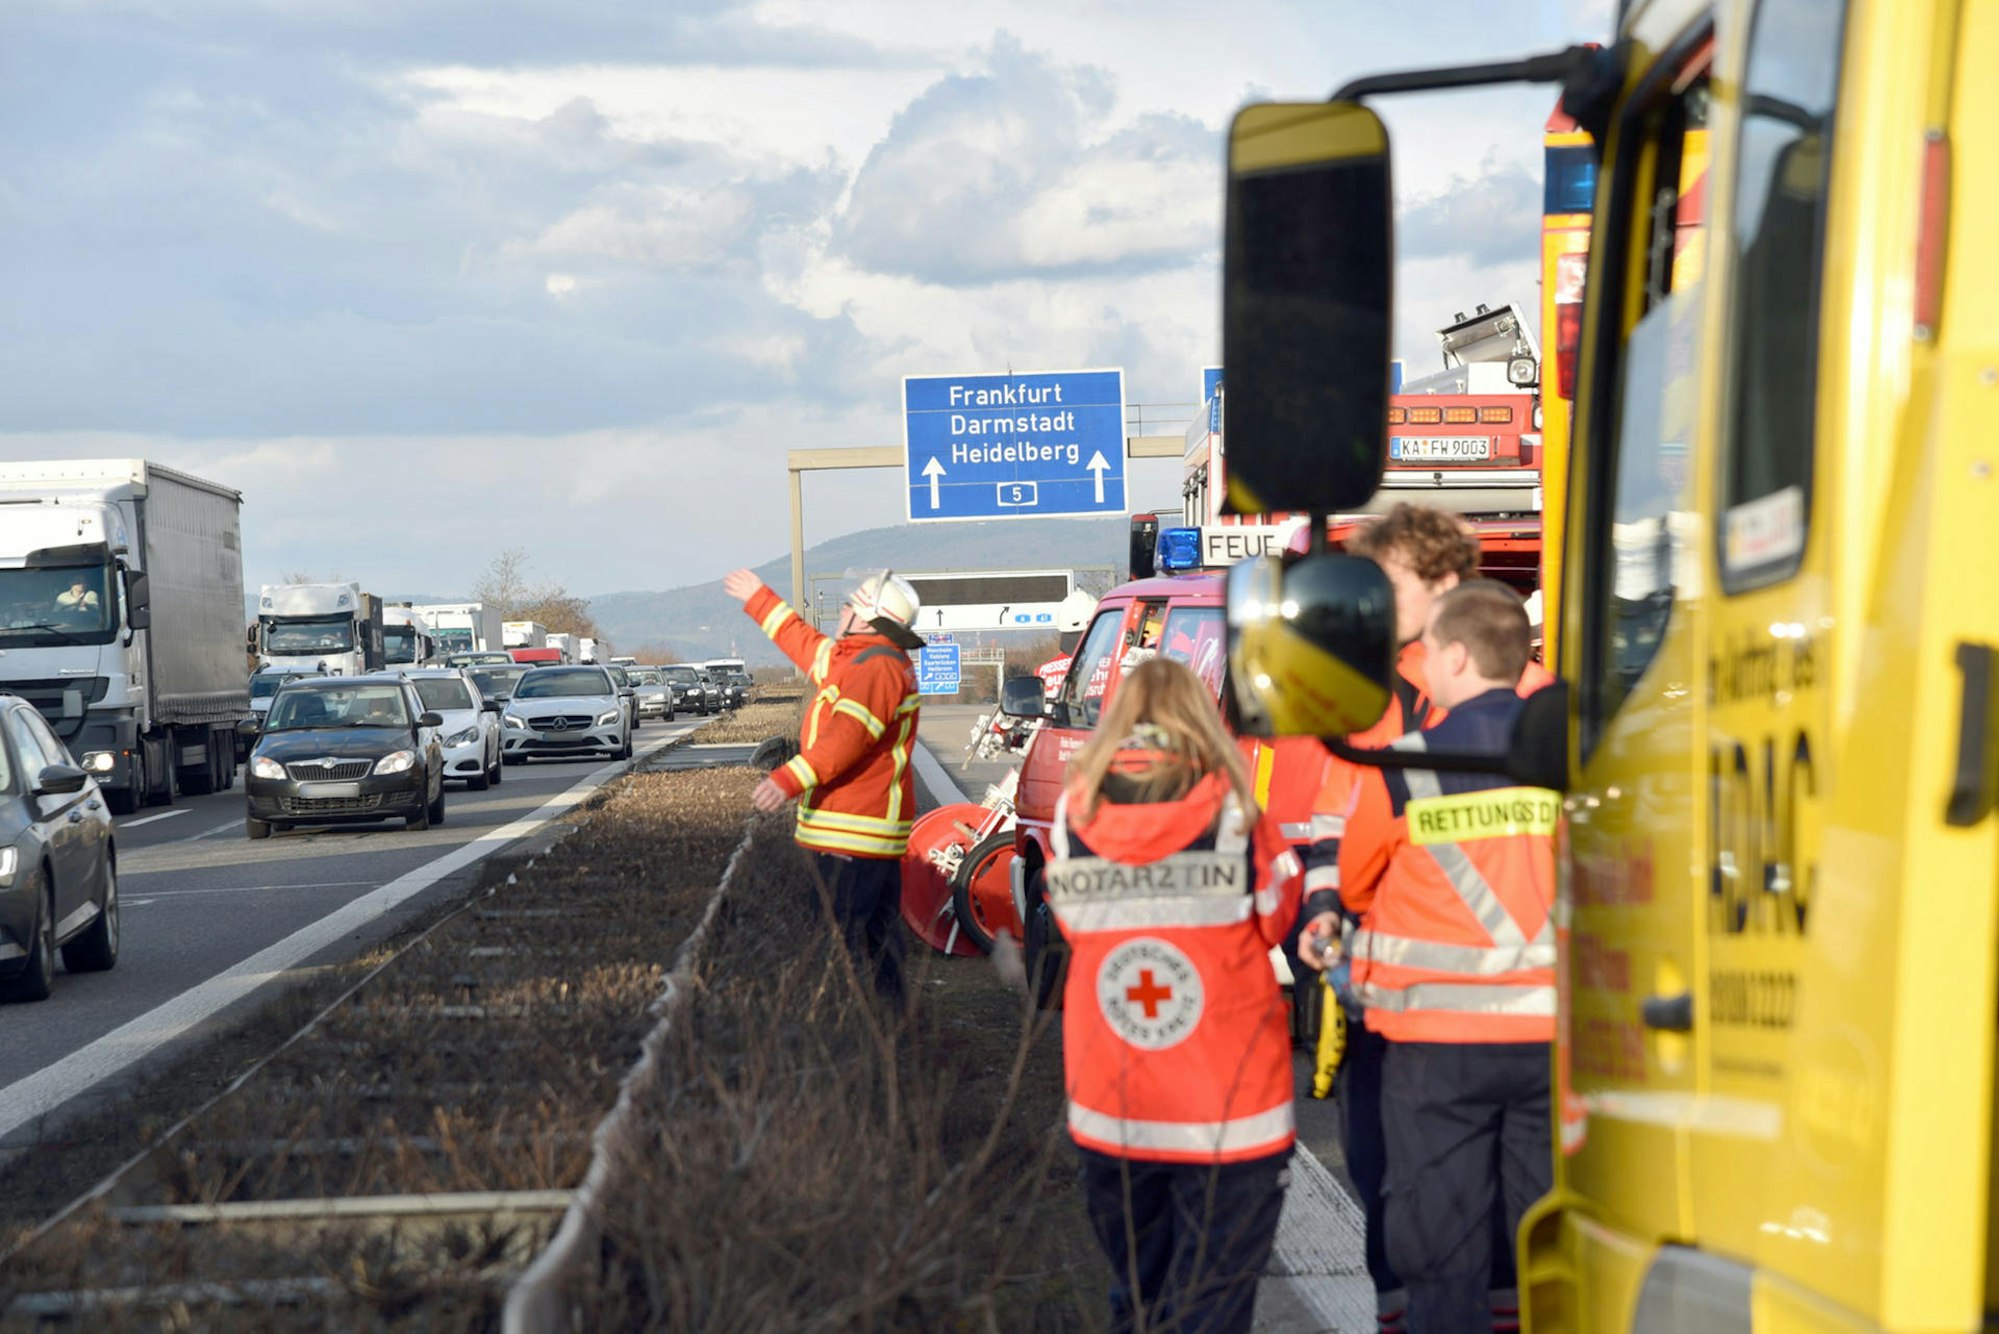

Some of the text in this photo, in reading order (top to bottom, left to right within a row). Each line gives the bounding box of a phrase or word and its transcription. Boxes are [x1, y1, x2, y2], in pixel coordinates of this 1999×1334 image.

[949, 384, 1062, 406] Frankfurt
[951, 412, 1075, 435] Darmstadt
[952, 442, 1079, 465] Heidelberg
[1402, 440, 1420, 455] KA
[1453, 440, 1487, 455] 9003
[1012, 486, 1022, 501] 5
